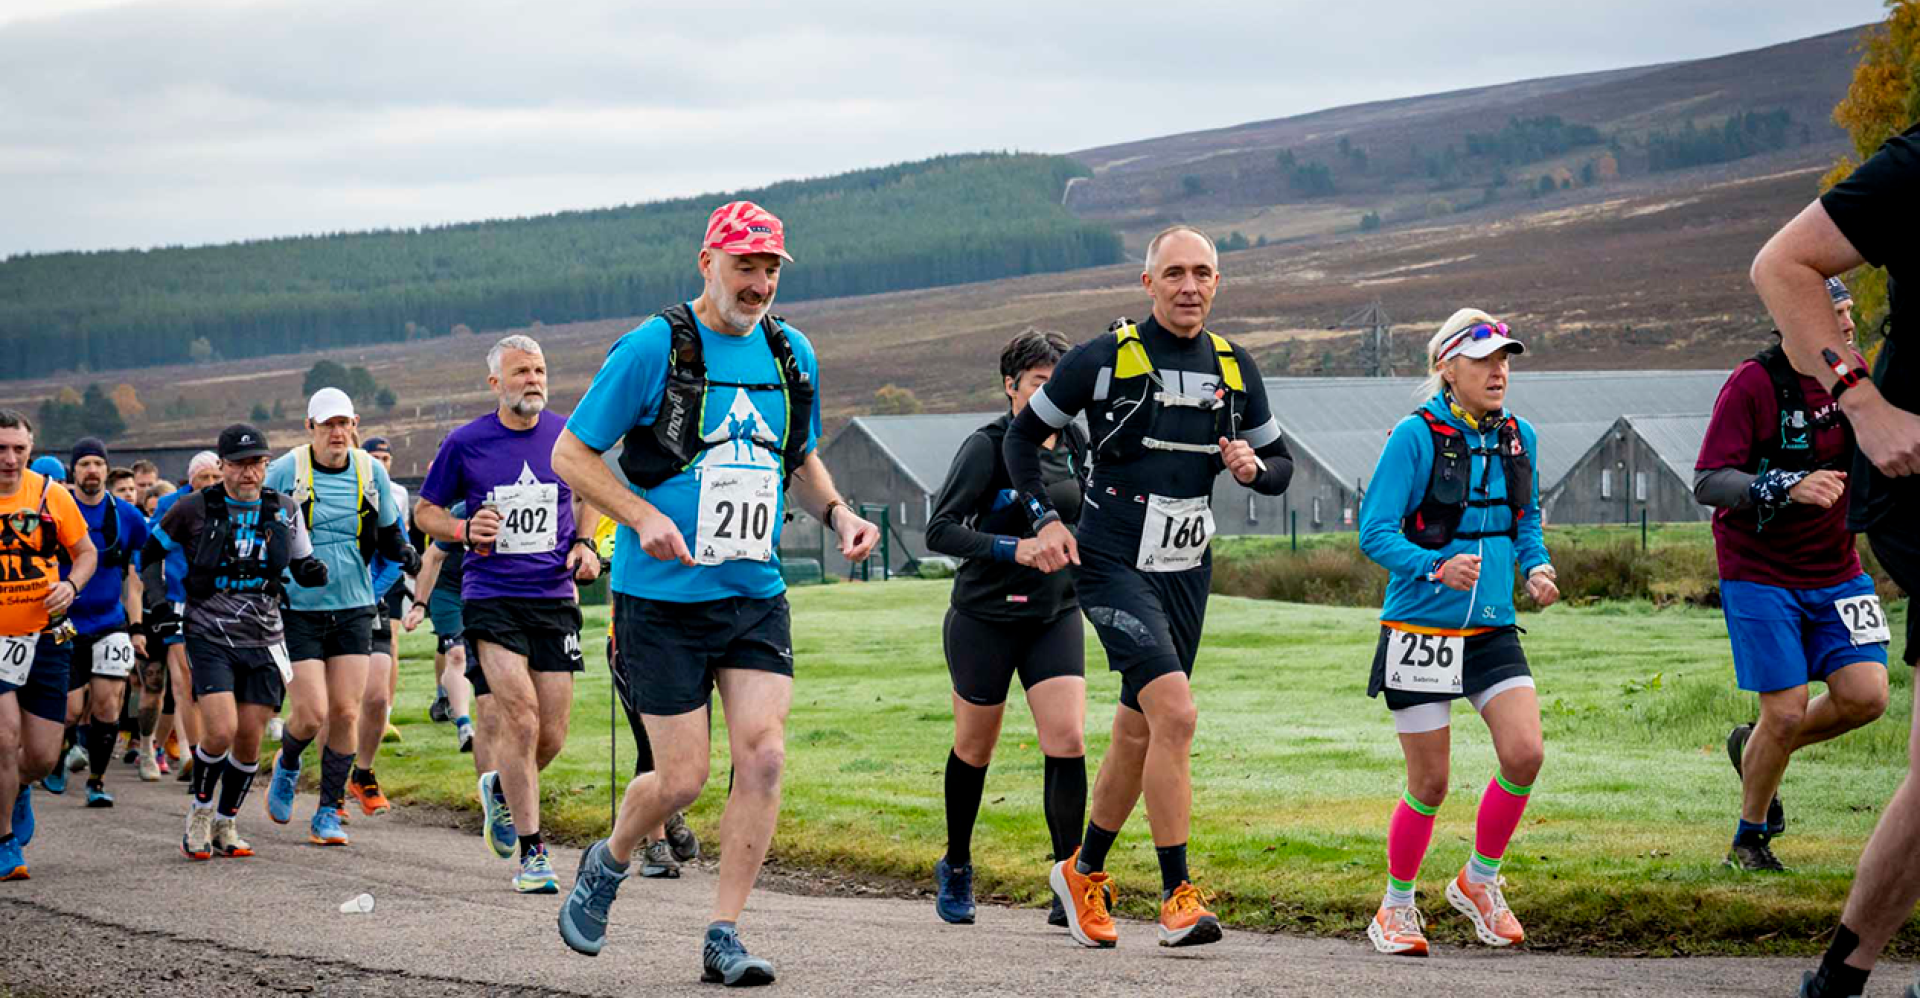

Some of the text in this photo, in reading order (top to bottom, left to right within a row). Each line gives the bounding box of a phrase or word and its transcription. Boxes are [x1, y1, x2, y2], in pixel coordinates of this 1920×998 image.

[505, 507, 548, 534] 402
[713, 500, 769, 540] 210
[1160, 515, 1206, 549] 160
[1482, 605, 1497, 619] SL
[1843, 599, 1886, 631] 23
[1399, 632, 1454, 668] 256
[1413, 675, 1439, 684] Sabrina
